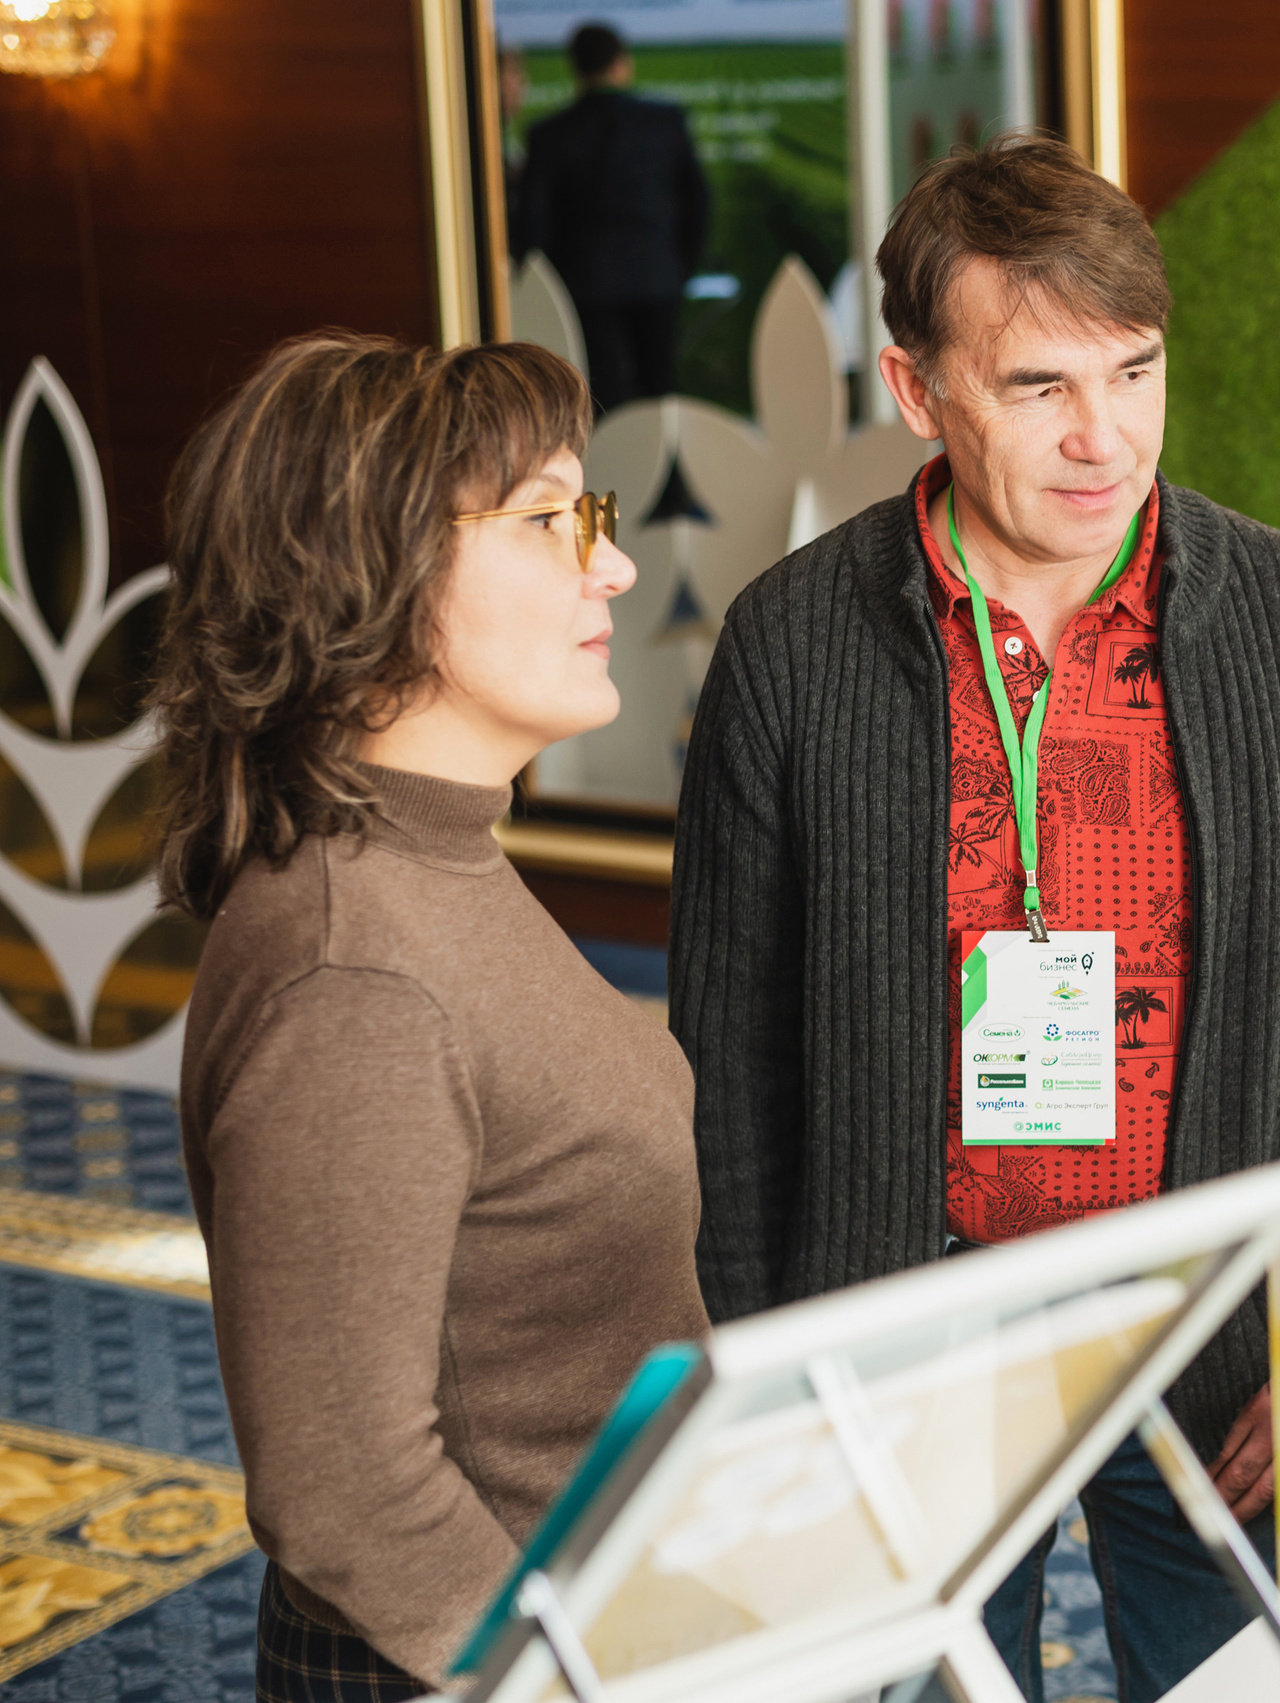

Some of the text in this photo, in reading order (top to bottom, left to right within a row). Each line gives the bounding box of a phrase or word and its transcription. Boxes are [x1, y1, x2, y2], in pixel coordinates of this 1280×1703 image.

[1040, 962, 1077, 971] бизнес
[976, 1098, 1024, 1110] syngenta
[1046, 1102, 1063, 1110] Агро
[1064, 1102, 1092, 1110] Эксперт
[1025, 1122, 1062, 1131] ЭМИС
